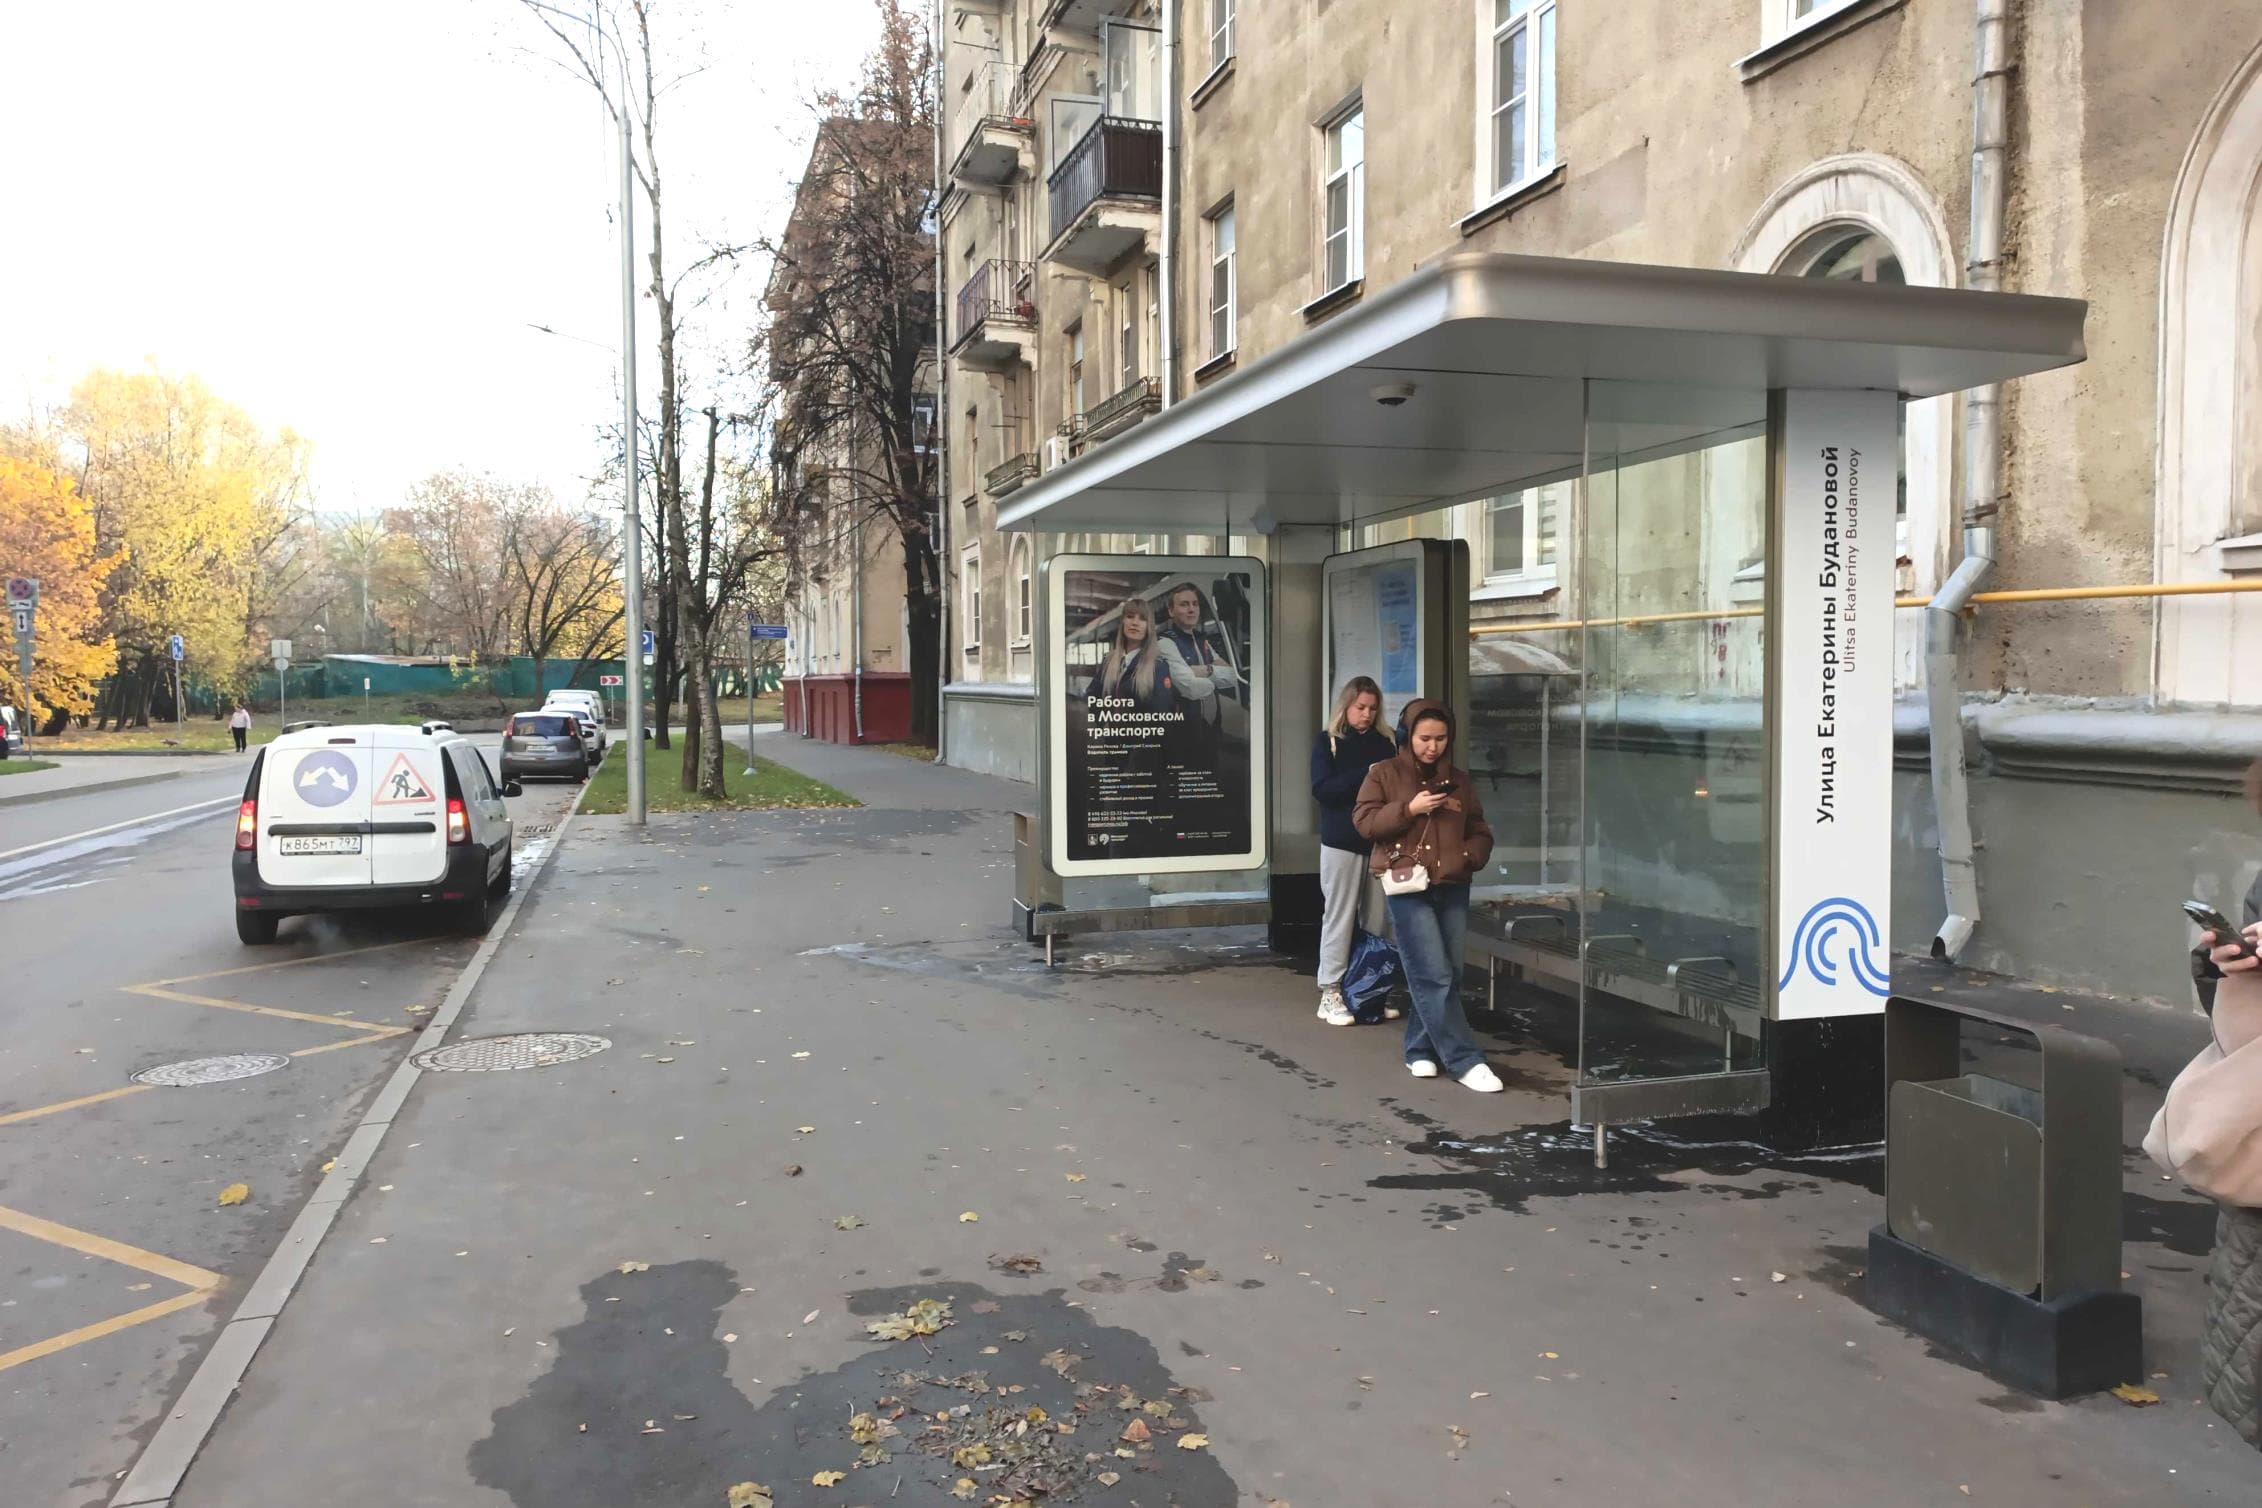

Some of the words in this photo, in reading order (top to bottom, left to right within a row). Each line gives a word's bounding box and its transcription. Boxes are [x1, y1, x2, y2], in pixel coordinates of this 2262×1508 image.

[1819, 447, 1841, 587] Будановой
[1845, 447, 1862, 539] Budanovoy
[1844, 545, 1859, 622] Ekateriny
[1818, 597, 1840, 737] Екатерины
[1843, 627, 1856, 672] Ulitsa
[1087, 695, 1135, 708] Работа
[1087, 713, 1096, 722] в
[1098, 710, 1185, 722] Московском
[1087, 727, 1165, 739] транспорте
[1816, 747, 1837, 824] Улица
